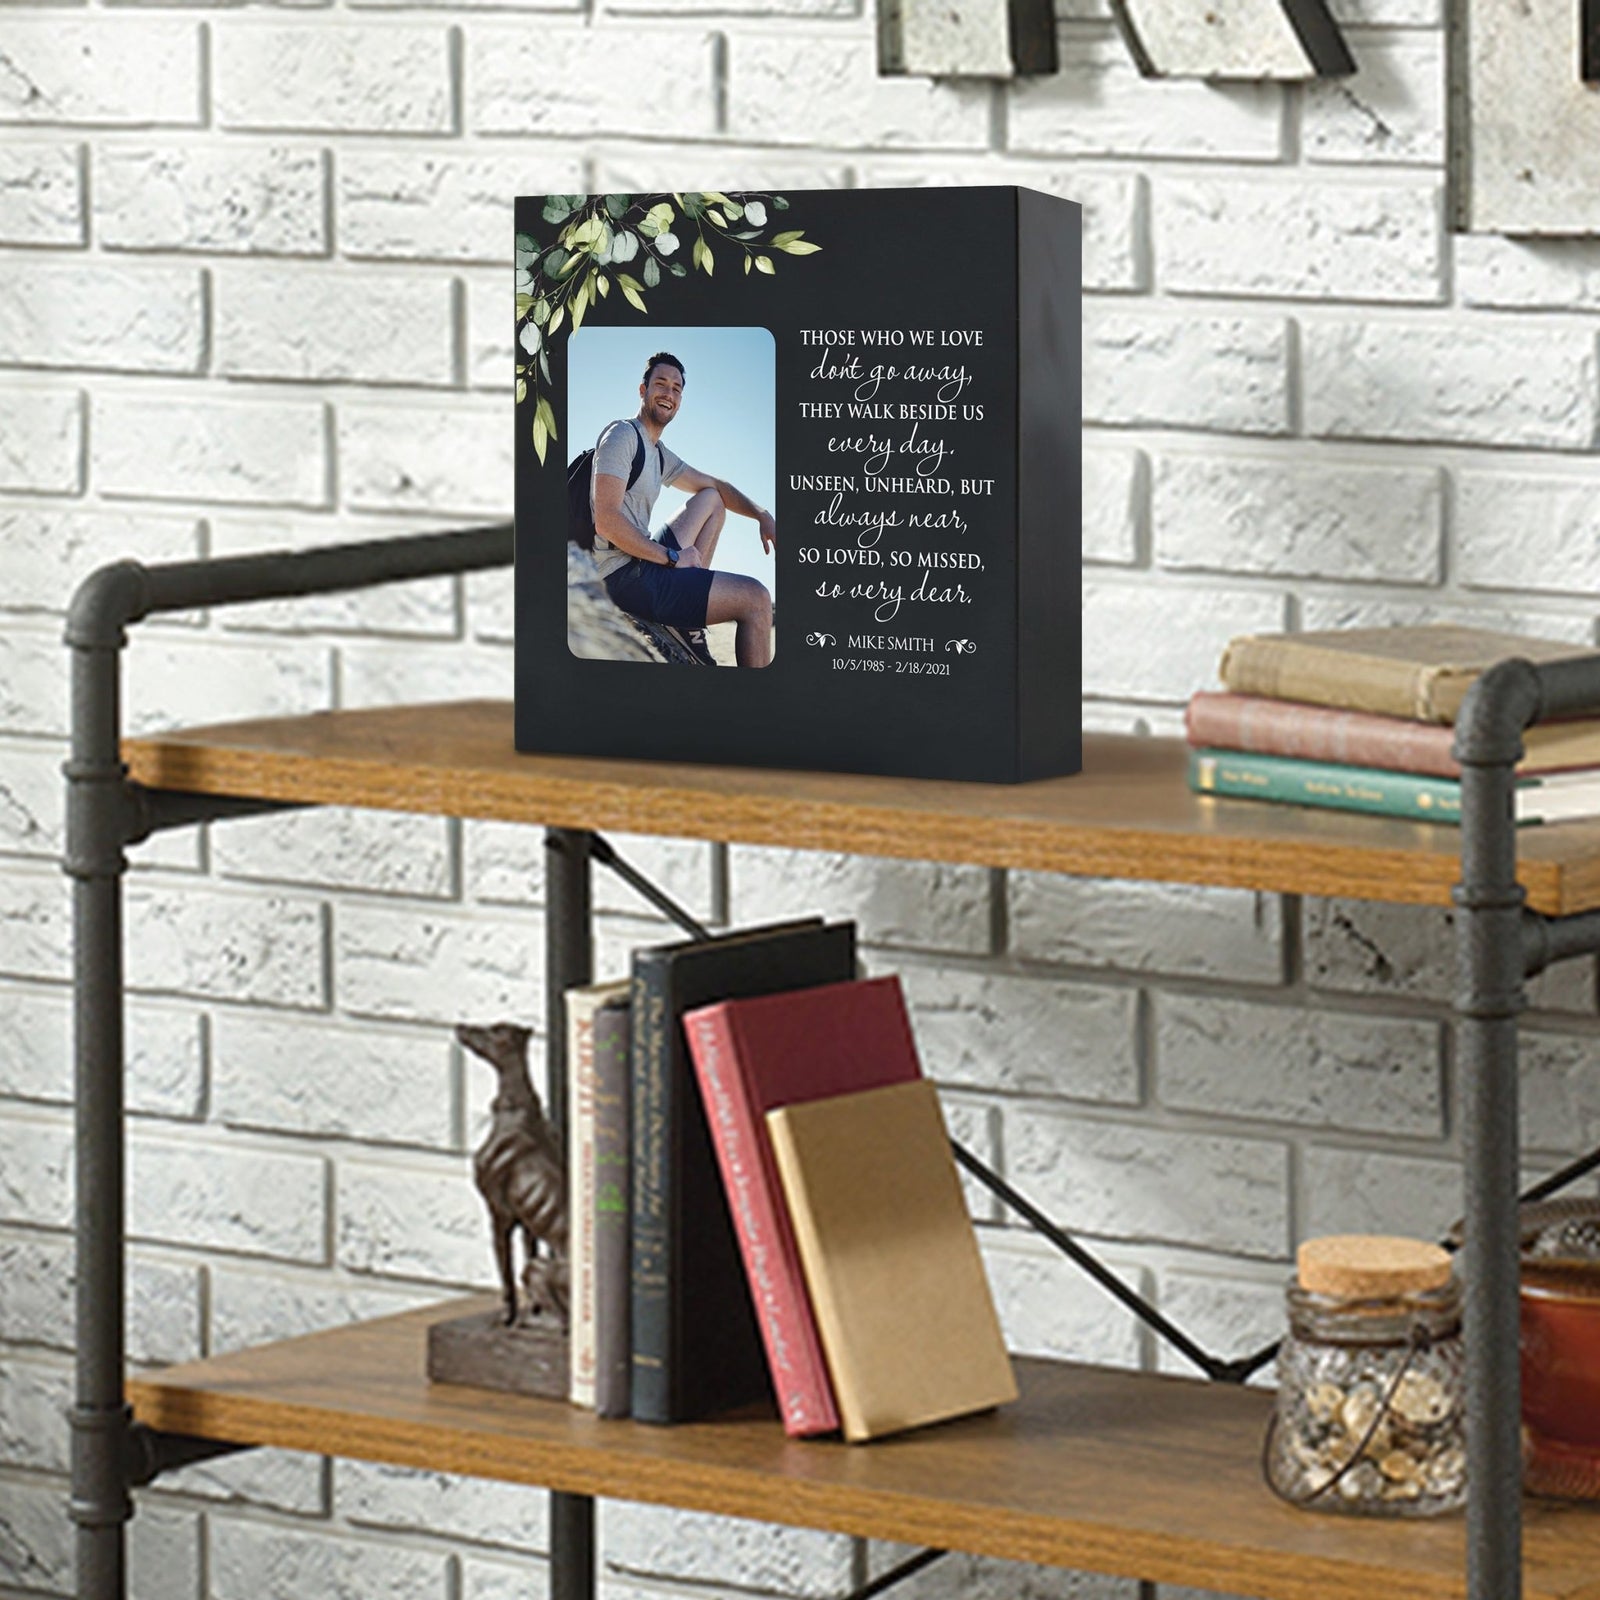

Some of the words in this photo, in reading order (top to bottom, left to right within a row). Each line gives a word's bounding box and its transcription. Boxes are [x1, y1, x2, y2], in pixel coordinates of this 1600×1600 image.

[799, 329, 856, 346] THOSE
[860, 329, 904, 346] WHO
[909, 330, 935, 346] WE
[940, 330, 984, 346] LOVE
[810, 347, 865, 380] don't
[854, 364, 901, 402] go
[903, 365, 973, 404] away,
[799, 402, 843, 419] THEY
[847, 403, 895, 420] WALK
[899, 404, 957, 420] BESIDE
[962, 405, 984, 421] US
[828, 433, 895, 475] every
[899, 421, 955, 477] day.
[789, 474, 860, 494] UNSEEN,
[864, 476, 955, 497] UNHEARD,
[960, 479, 995, 496] BUT
[814, 492, 904, 549] always
[908, 509, 968, 535] near,
[798, 547, 820, 564] SO
[825, 548, 885, 568] LOVED,
[889, 551, 912, 567] SO
[917, 551, 985, 572] MISSED,
[815, 580, 845, 598] so
[849, 580, 906, 623] very
[910, 569, 972, 604] dear.
[847, 634, 885, 650] MIKE
[887, 635, 934, 652] SMITH
[832, 658, 885, 672] 10/5/1985
[895, 661, 950, 675] 2/18/2021
